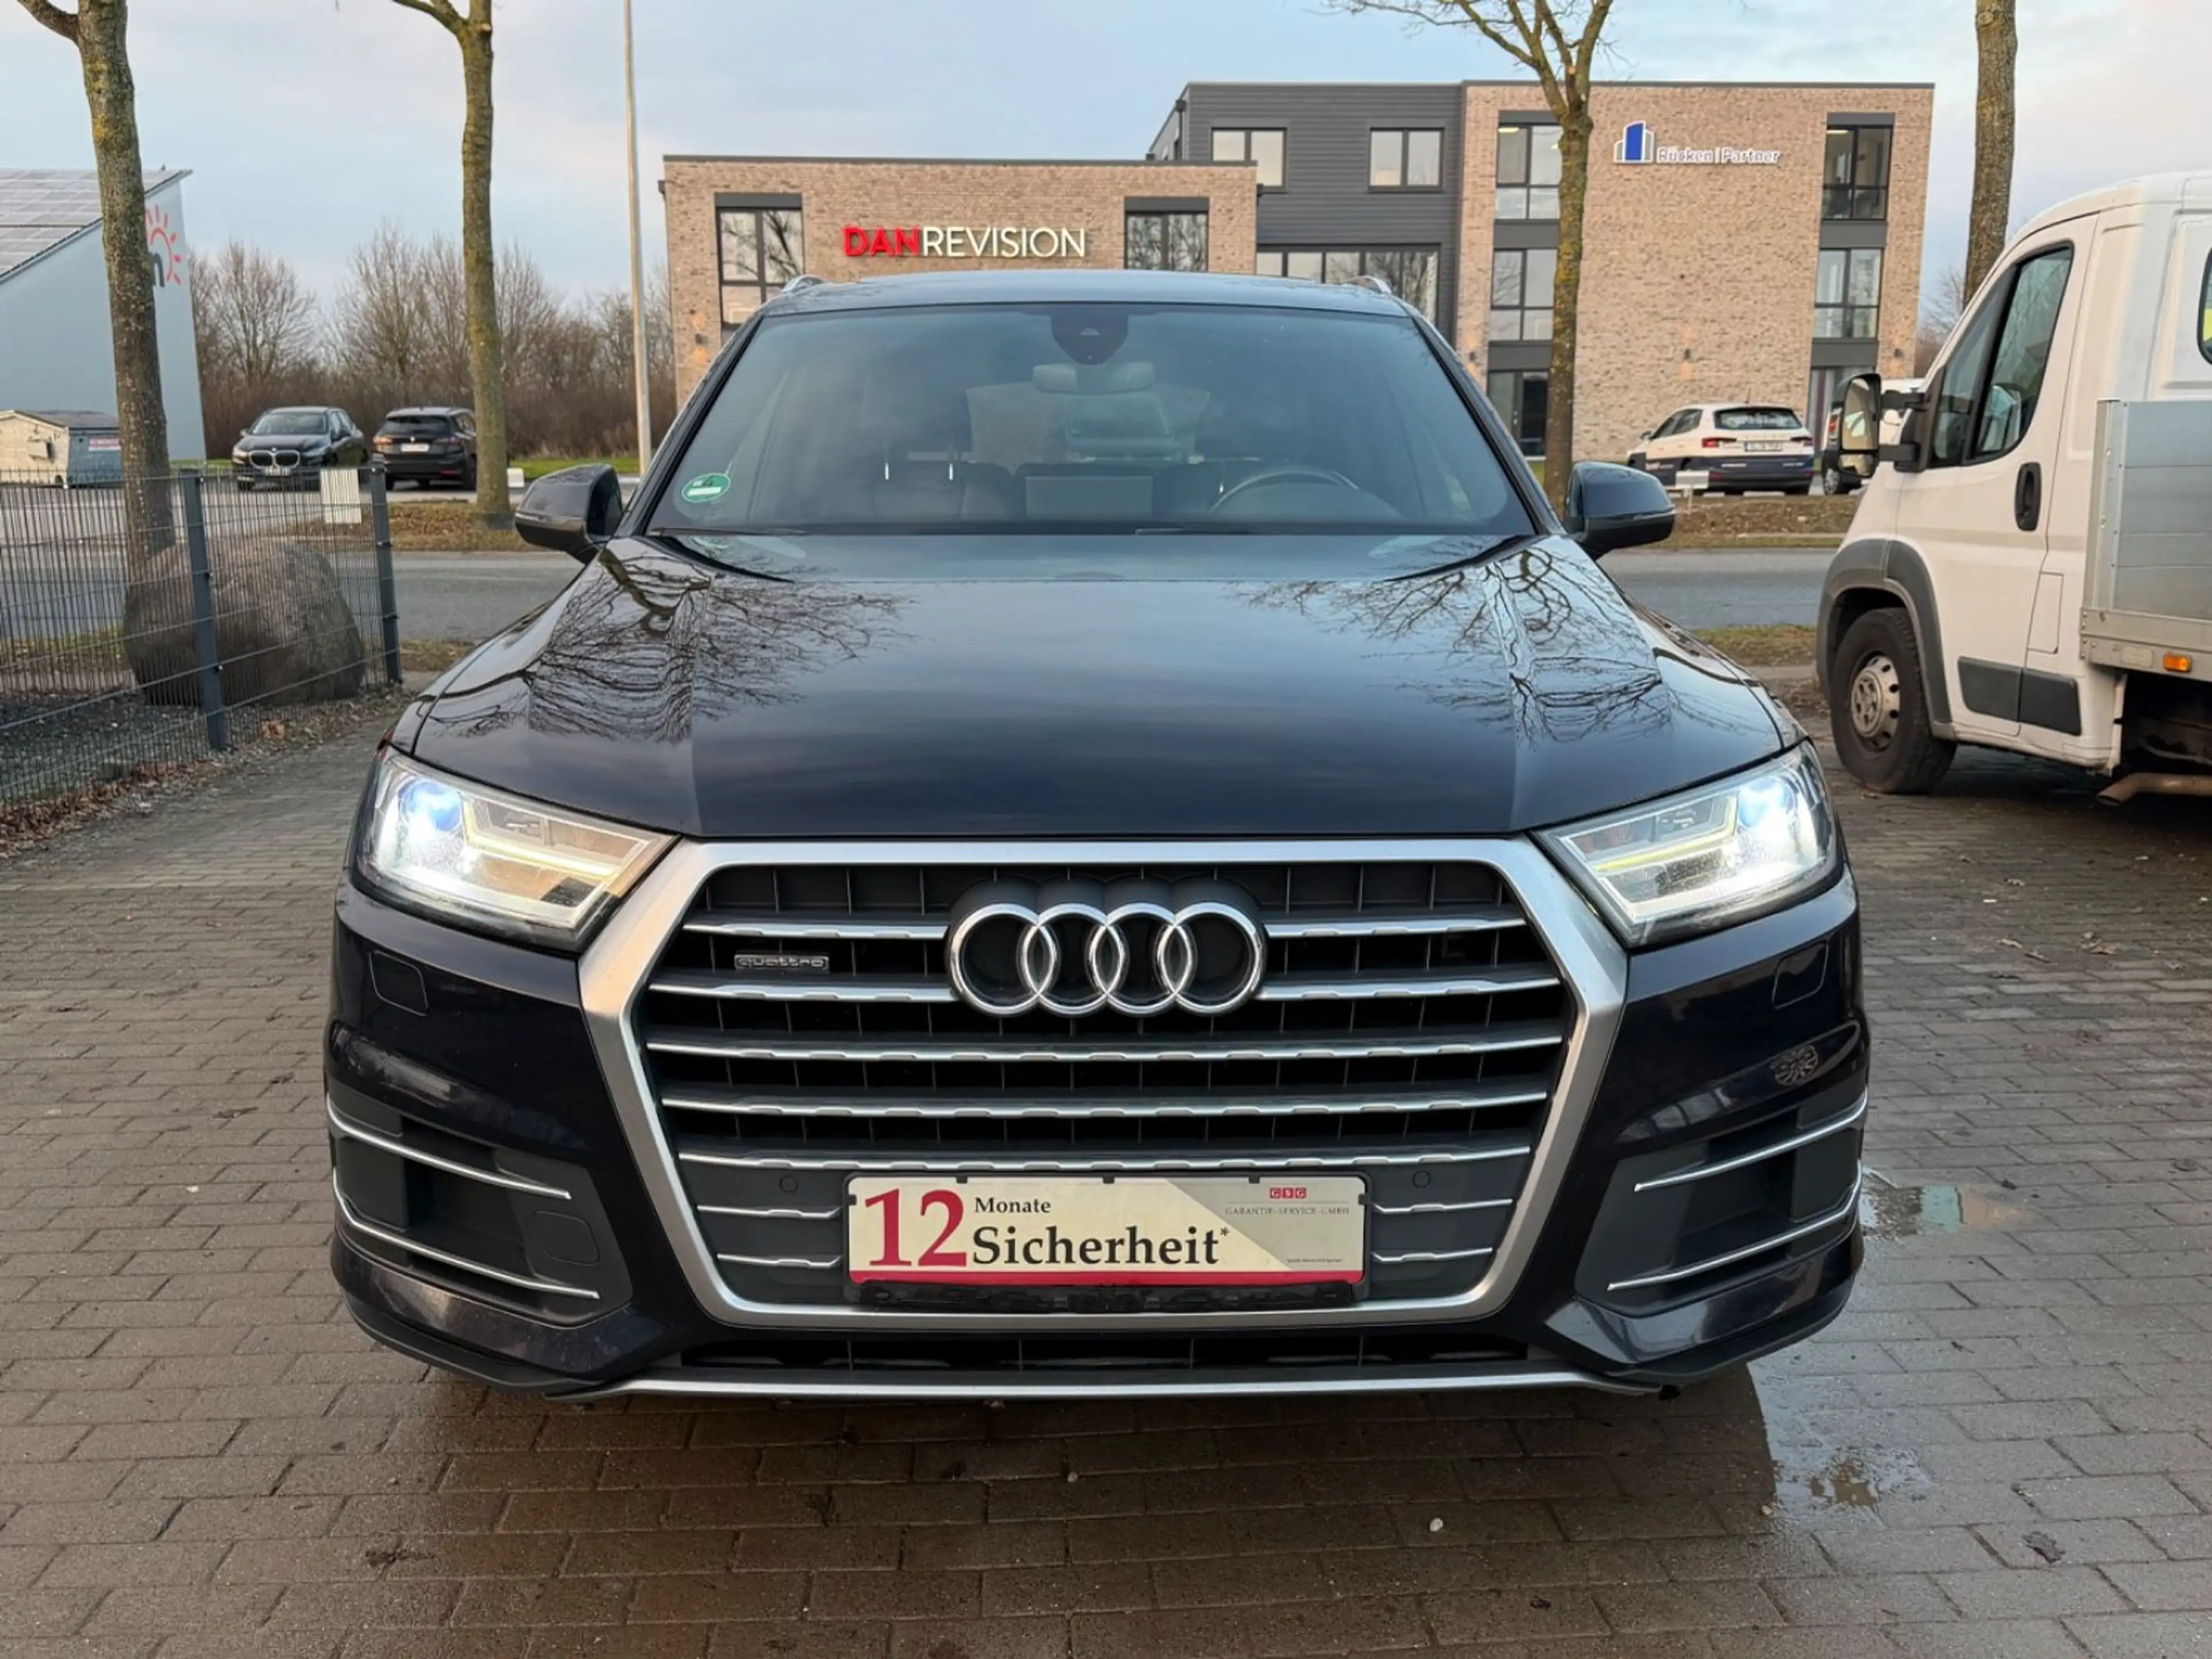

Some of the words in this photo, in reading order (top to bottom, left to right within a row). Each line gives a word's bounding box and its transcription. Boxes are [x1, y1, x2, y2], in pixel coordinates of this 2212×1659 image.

[1721, 147, 1780, 164] Partner
[842, 225, 1086, 257] DANREVISION
[738, 957, 824, 969] quattro
[1270, 1188, 1306, 1199] GSG
[974, 1196, 1051, 1214] Monate
[865, 1187, 967, 1268] 12
